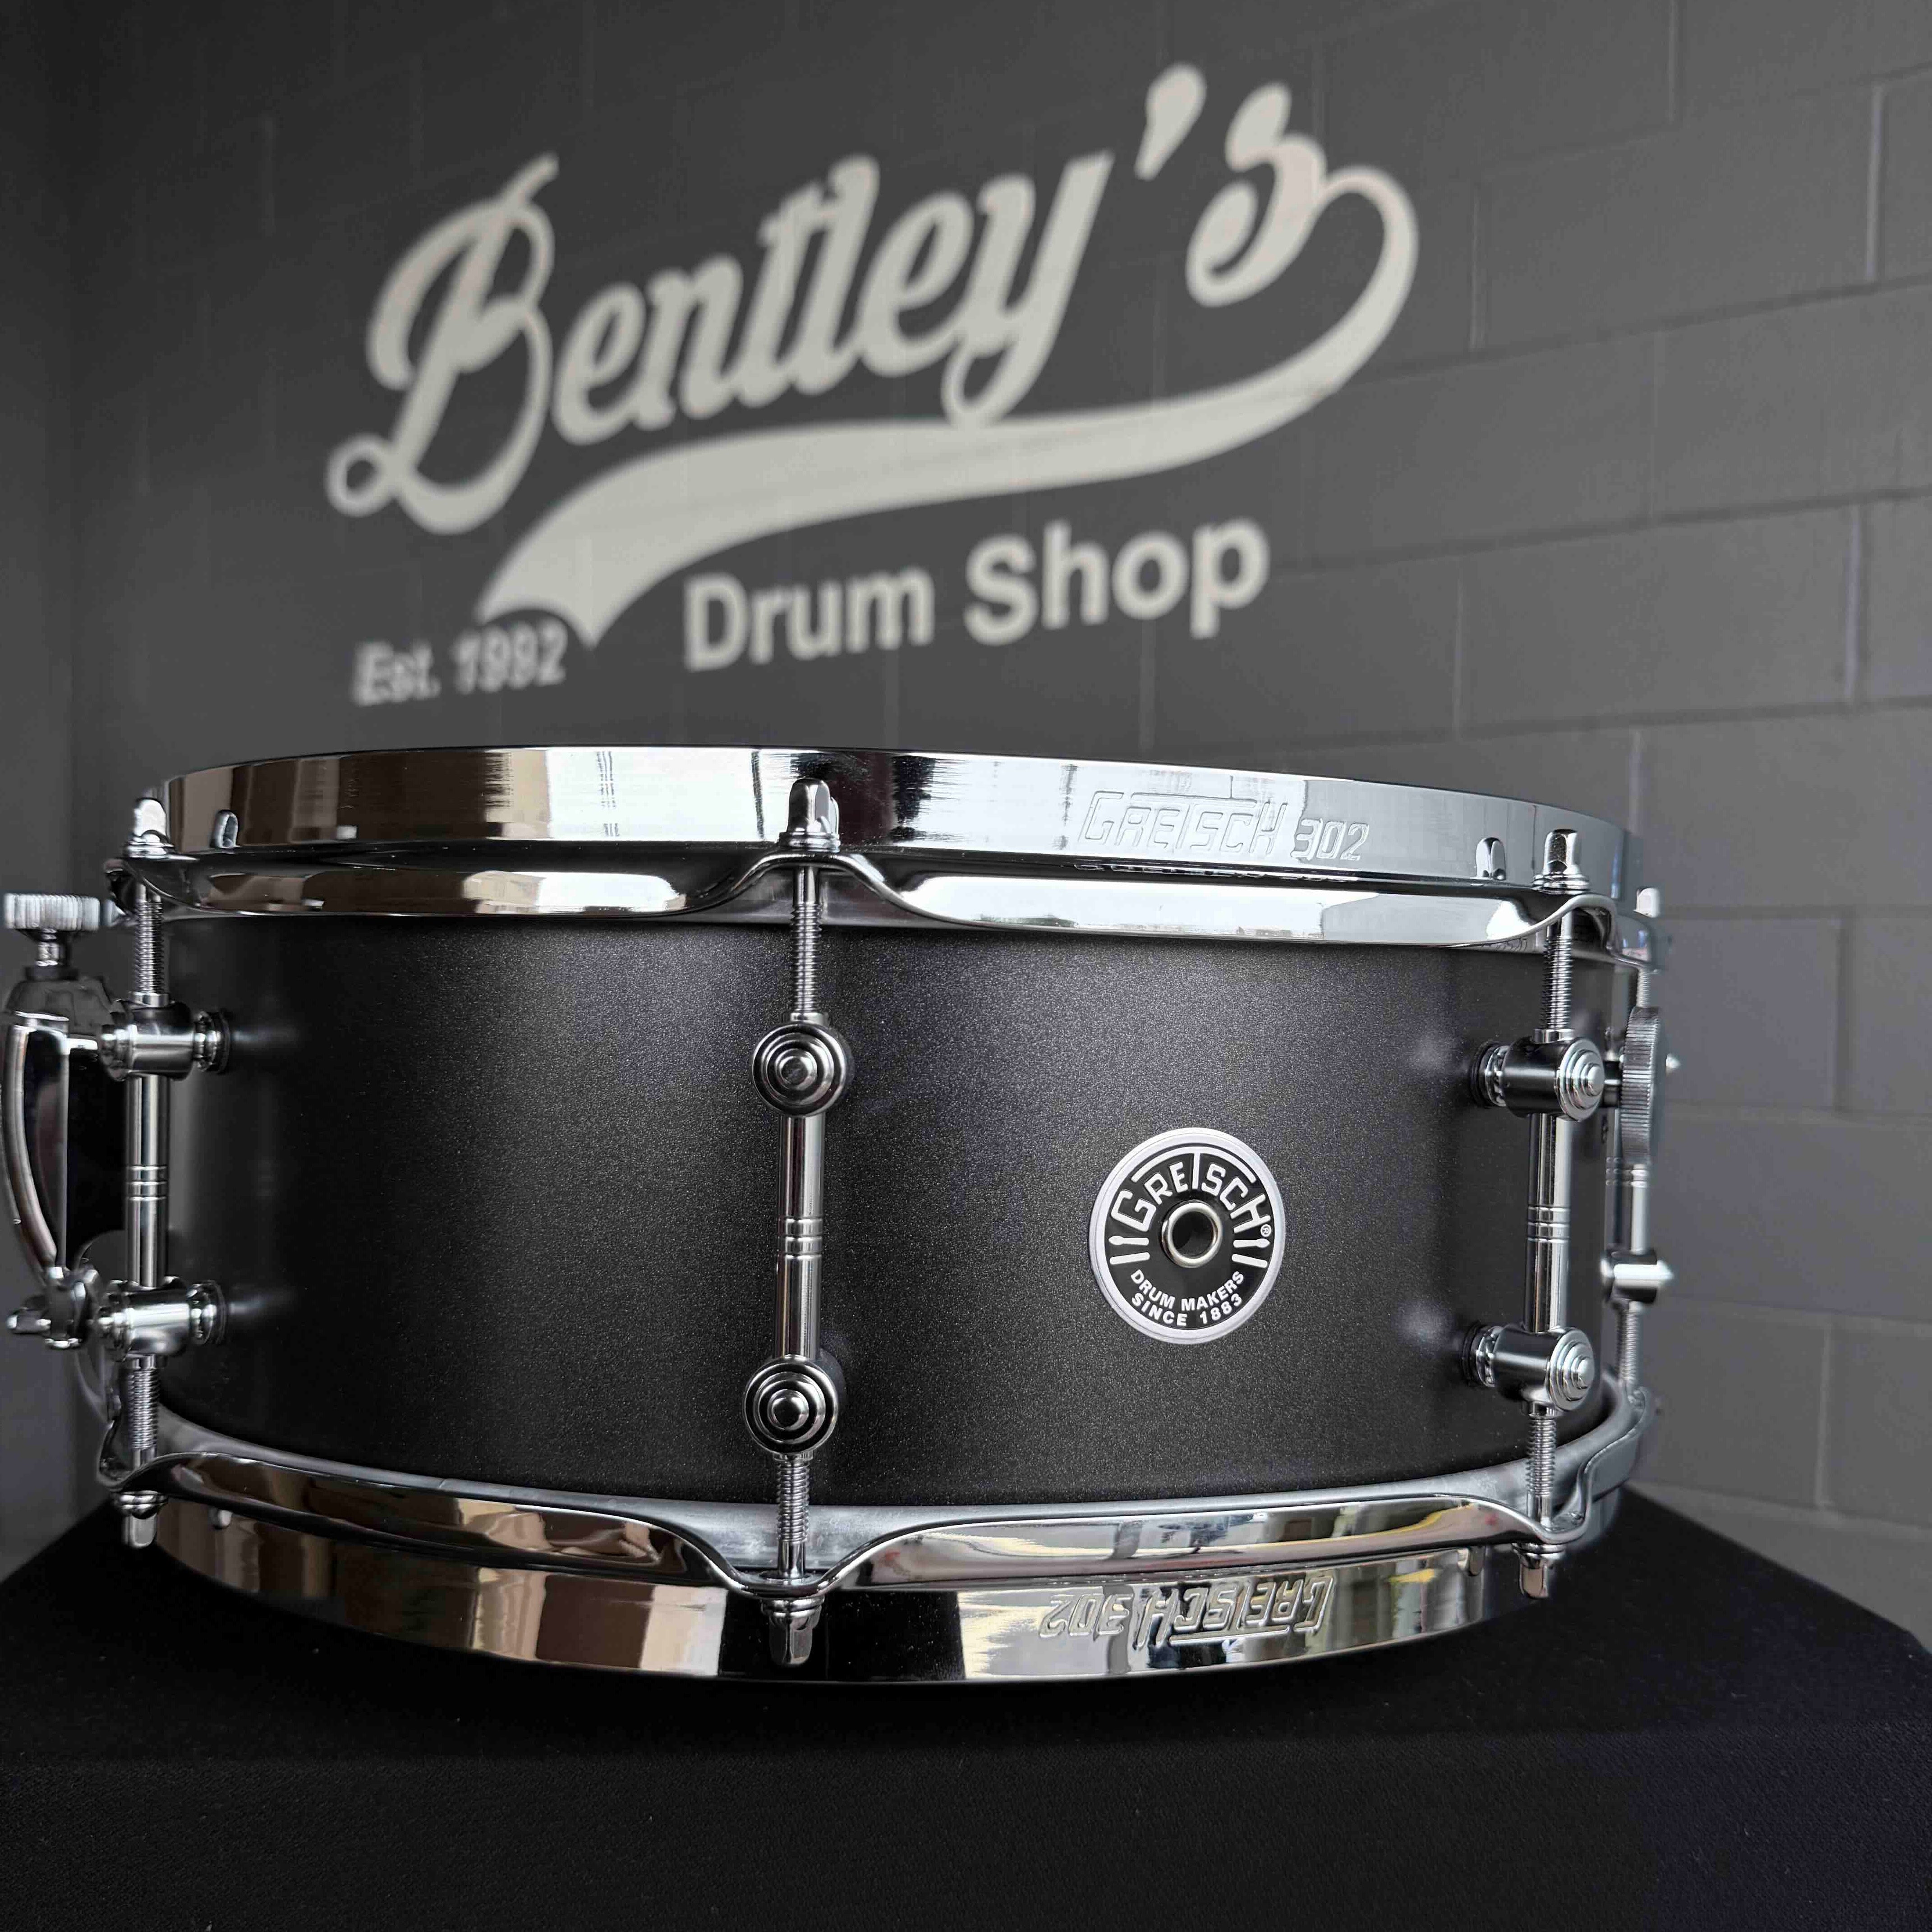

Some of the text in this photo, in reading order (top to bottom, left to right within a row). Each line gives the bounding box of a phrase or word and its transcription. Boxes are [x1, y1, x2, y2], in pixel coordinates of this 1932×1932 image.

[329, 64, 1418, 534] Bentley's
[685, 518, 1271, 670] Drum Shop
[452, 620, 568, 693] 1992
[1078, 790, 1370, 862] GRETSCH 302
[1131, 1269, 1244, 1311] DRUM MAKERS
[1132, 1293, 1242, 1327] SINCE 1883
[1132, 1576, 1334, 1651] GRETSCH
